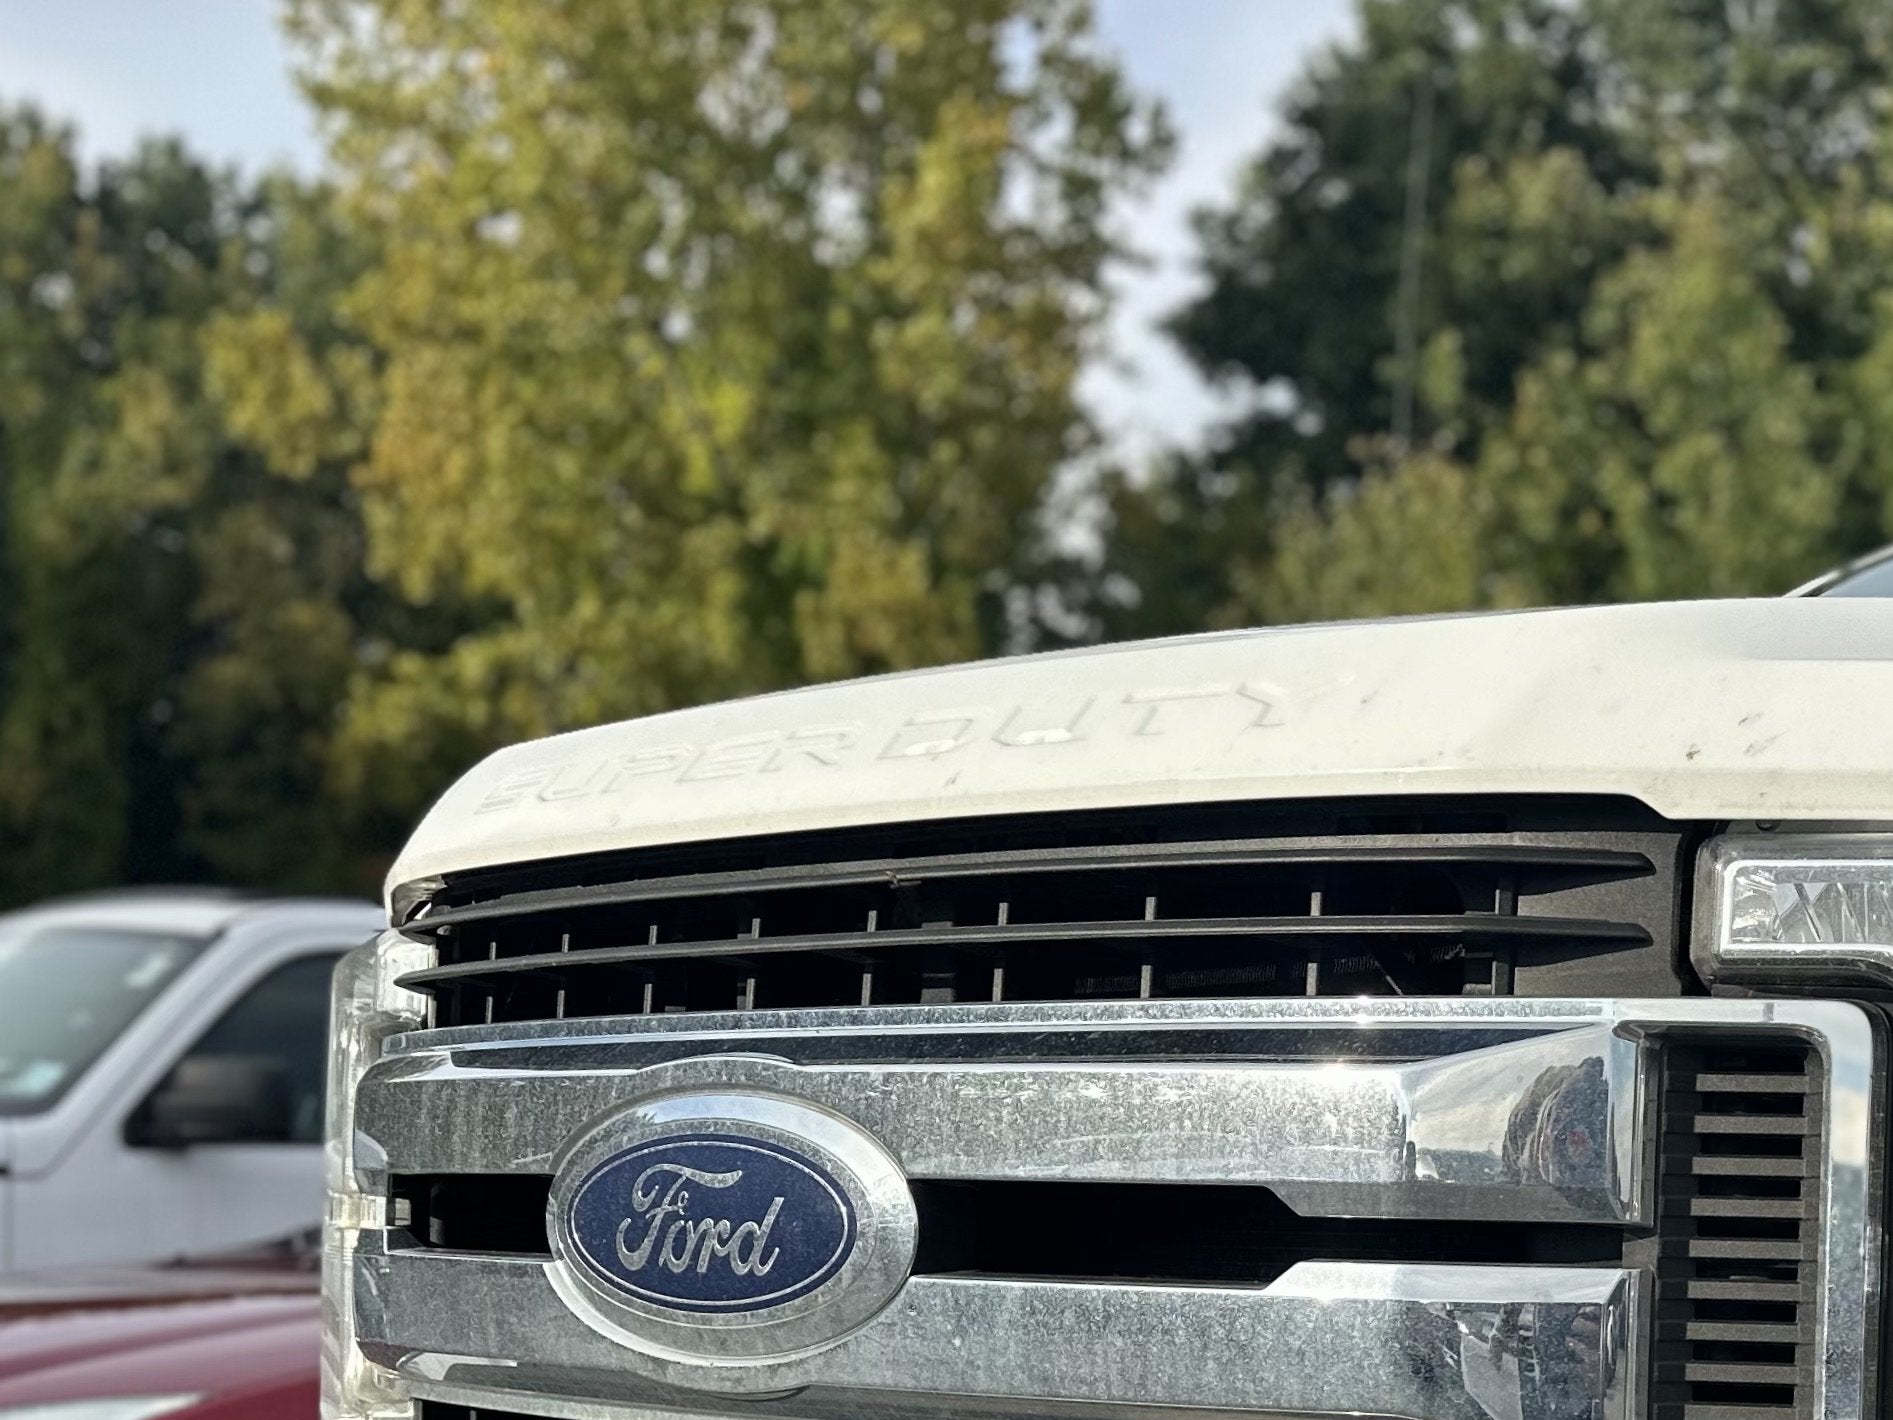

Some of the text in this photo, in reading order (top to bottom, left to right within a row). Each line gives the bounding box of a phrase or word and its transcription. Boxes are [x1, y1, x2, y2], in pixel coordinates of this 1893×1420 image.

[473, 674, 1350, 816] SUPER DUTY
[615, 1163, 785, 1277] Ford
